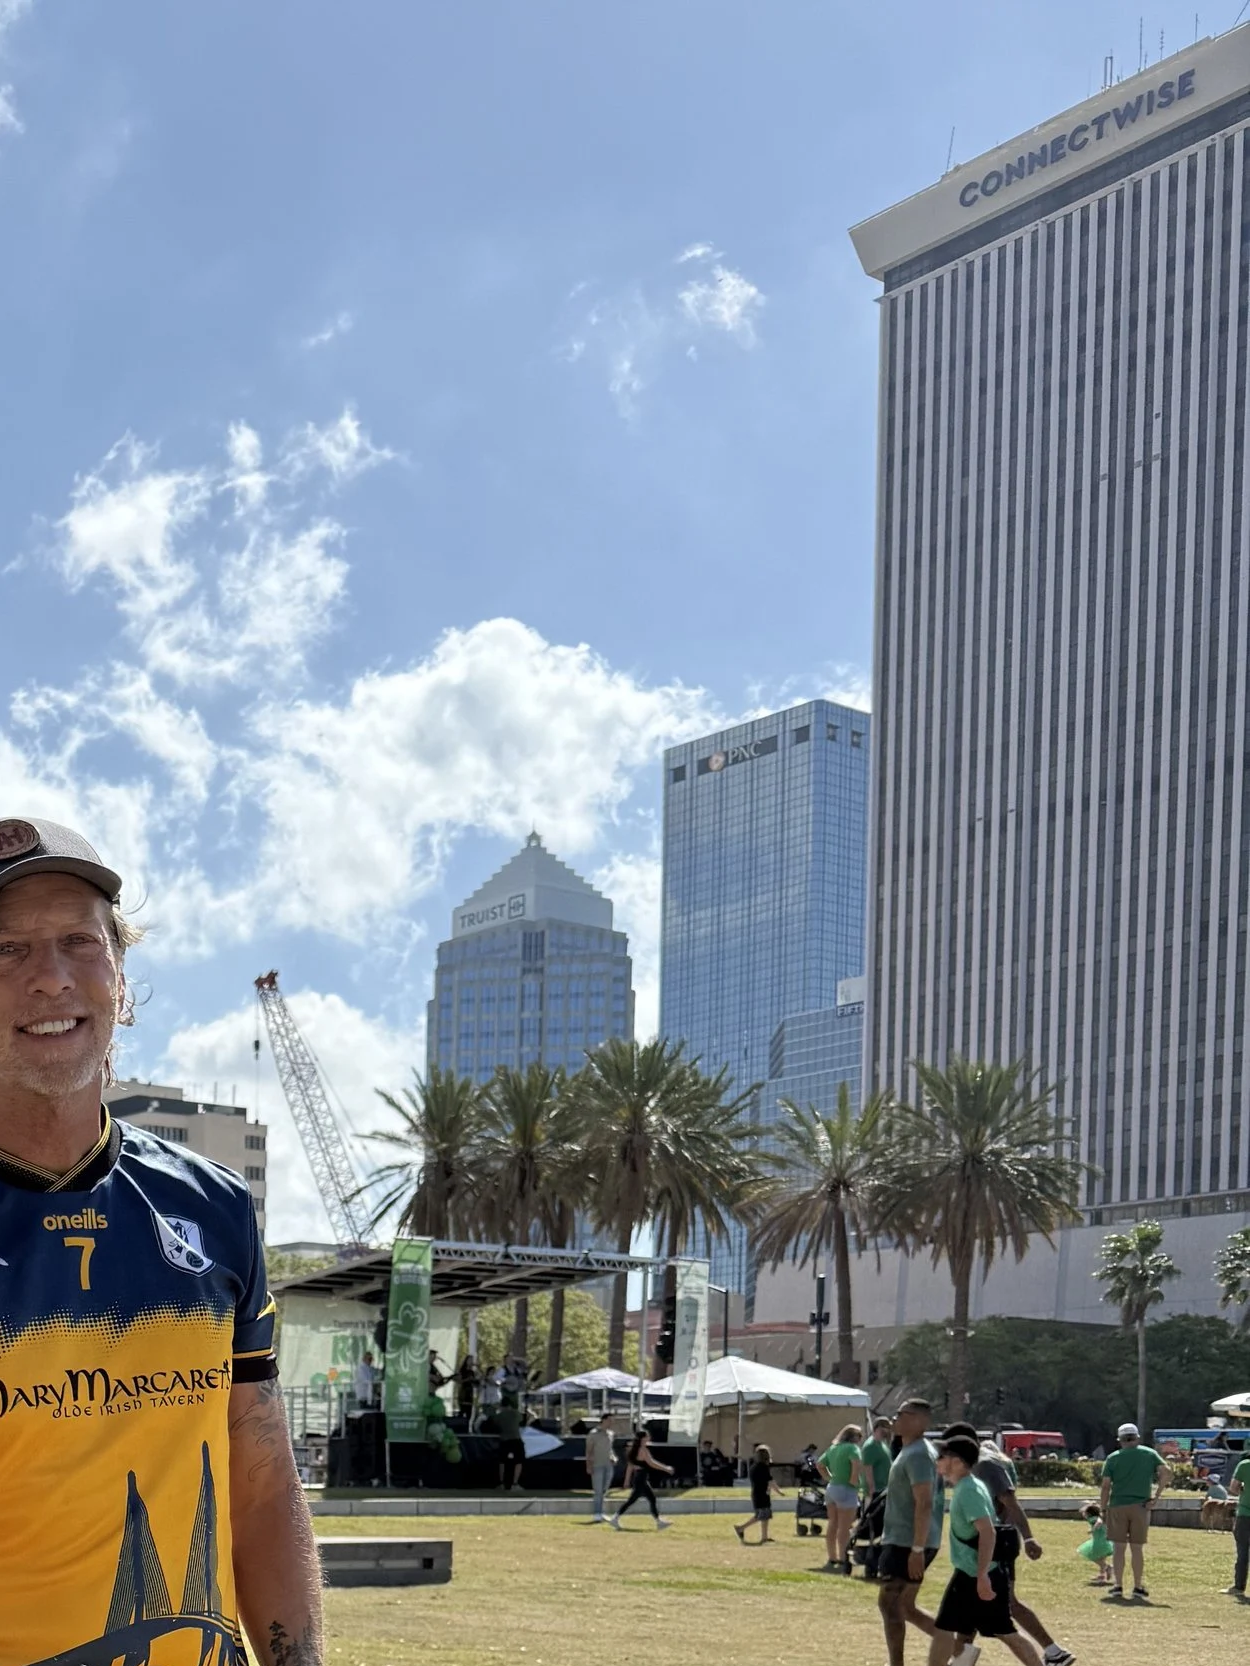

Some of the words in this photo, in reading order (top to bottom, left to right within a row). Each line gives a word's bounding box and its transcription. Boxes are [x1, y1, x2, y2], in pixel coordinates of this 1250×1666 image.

[958, 68, 1197, 208] CONNECTWISE
[727, 740, 763, 765] PNC
[460, 902, 507, 930] TRUIST
[63, 1236, 96, 1291] 7
[52, 1404, 93, 1419] OLDE
[99, 1399, 143, 1417] IRISH
[149, 1393, 206, 1408] TAVERN
